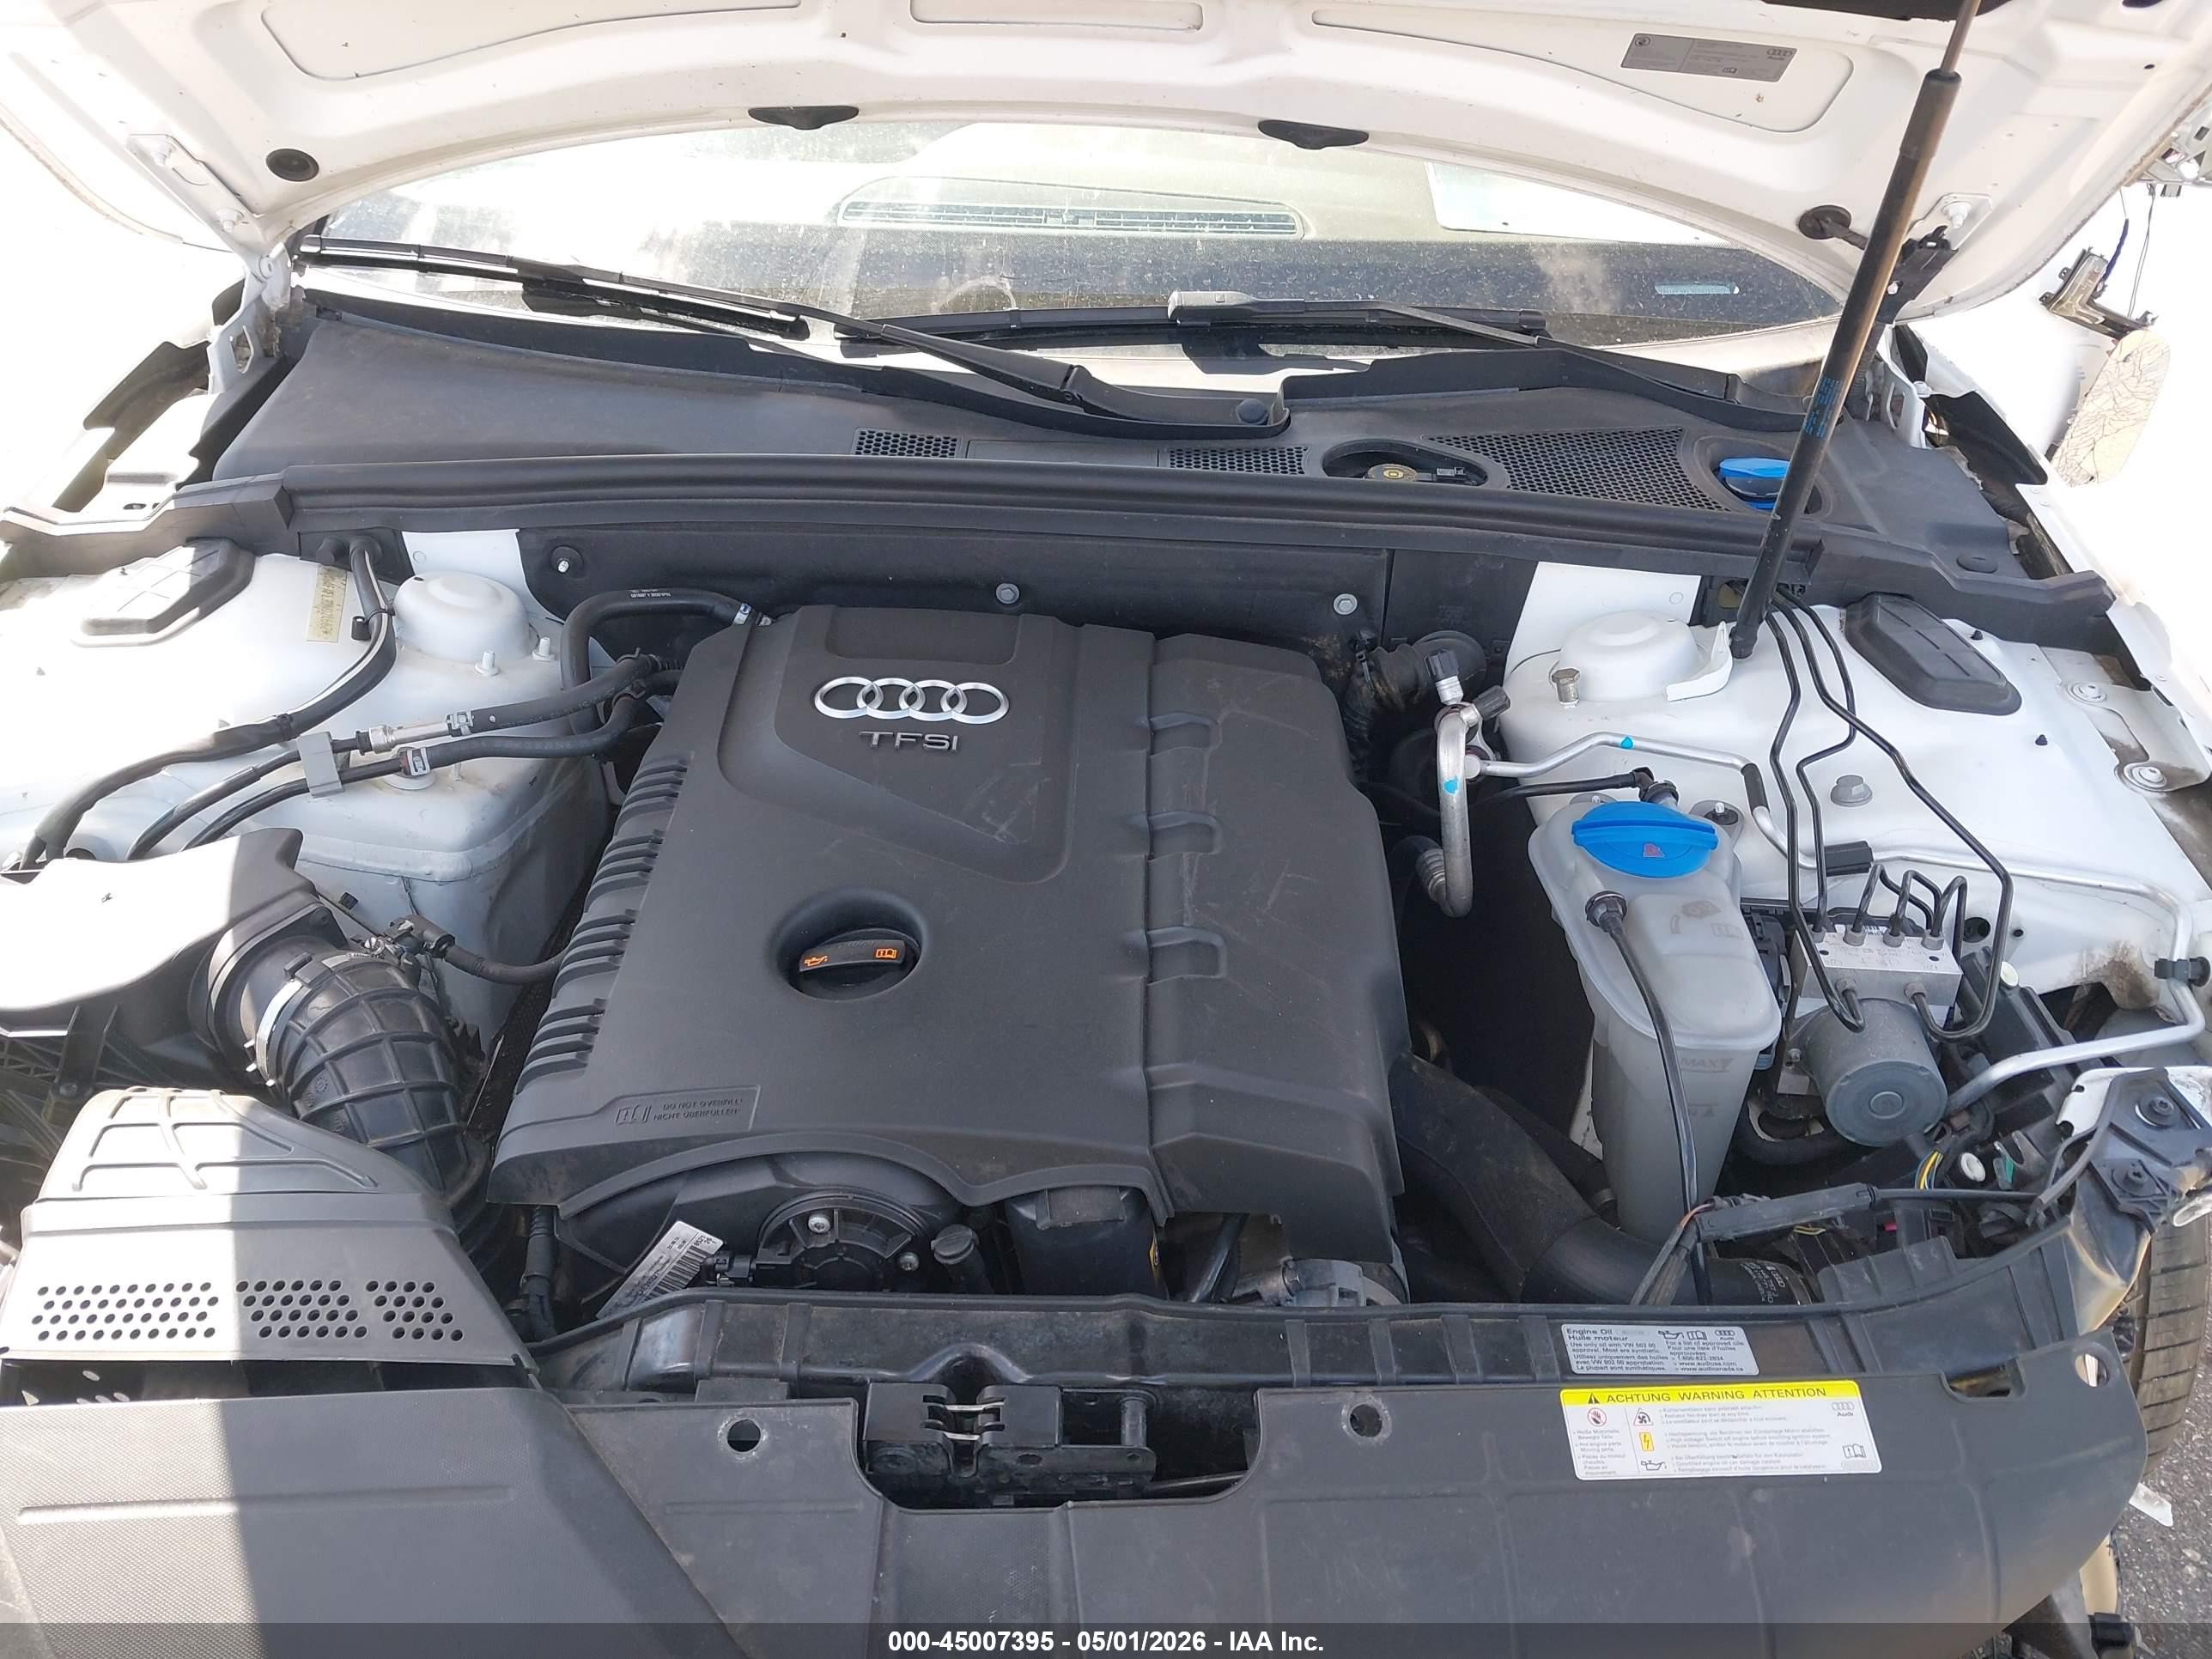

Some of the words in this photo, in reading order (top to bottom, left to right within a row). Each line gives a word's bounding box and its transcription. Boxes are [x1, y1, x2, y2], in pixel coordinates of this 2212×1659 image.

[860, 730, 958, 752] TFSI
[1607, 1393, 1671, 1404] ACHTUNG
[1678, 1390, 1745, 1401] WARNING
[1753, 1388, 1826, 1399] ATTENTION
